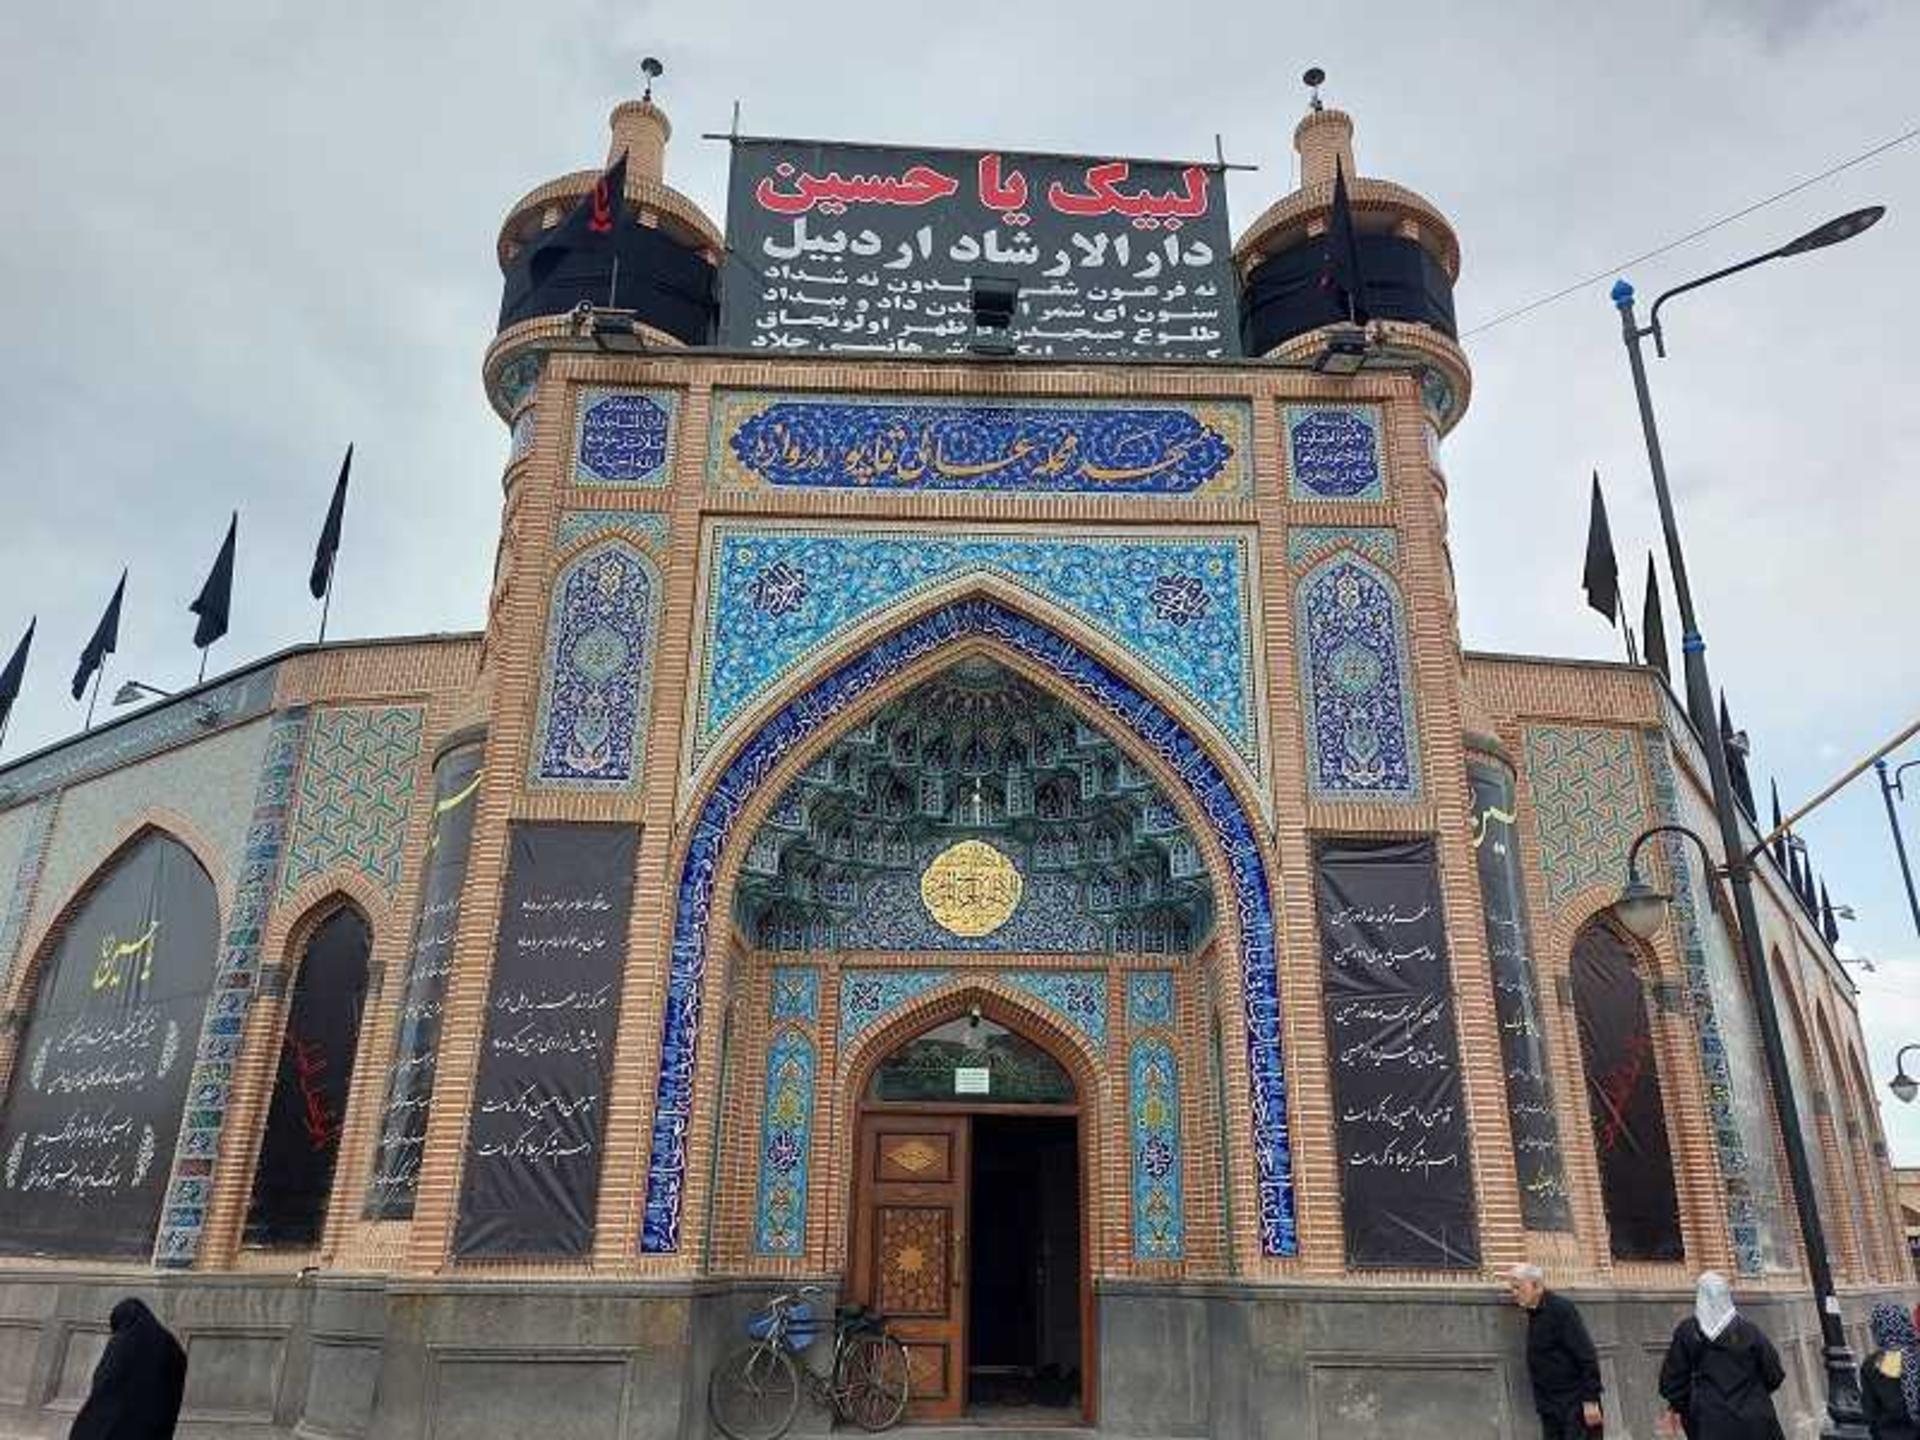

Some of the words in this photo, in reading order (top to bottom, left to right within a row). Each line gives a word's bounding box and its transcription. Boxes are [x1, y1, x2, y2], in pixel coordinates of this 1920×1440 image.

[756, 162, 959, 214] حسین
[979, 154, 1031, 226] یا
[1049, 162, 1209, 231] لبیک
[763, 216, 932, 269] اردبیل
[764, 265, 849, 284] شداد
[856, 272, 879, 286] نه
[1087, 280, 1187, 301] فرعون
[1195, 279, 1217, 296] نه
[763, 287, 848, 309] بیداد
[854, 298, 869, 312] و
[877, 295, 918, 310] داد
[1038, 303, 1086, 321] شمر
[1093, 304, 1126, 322] ای
[898, 318, 968, 336] ظهر
[1132, 326, 1221, 344] طلوع
